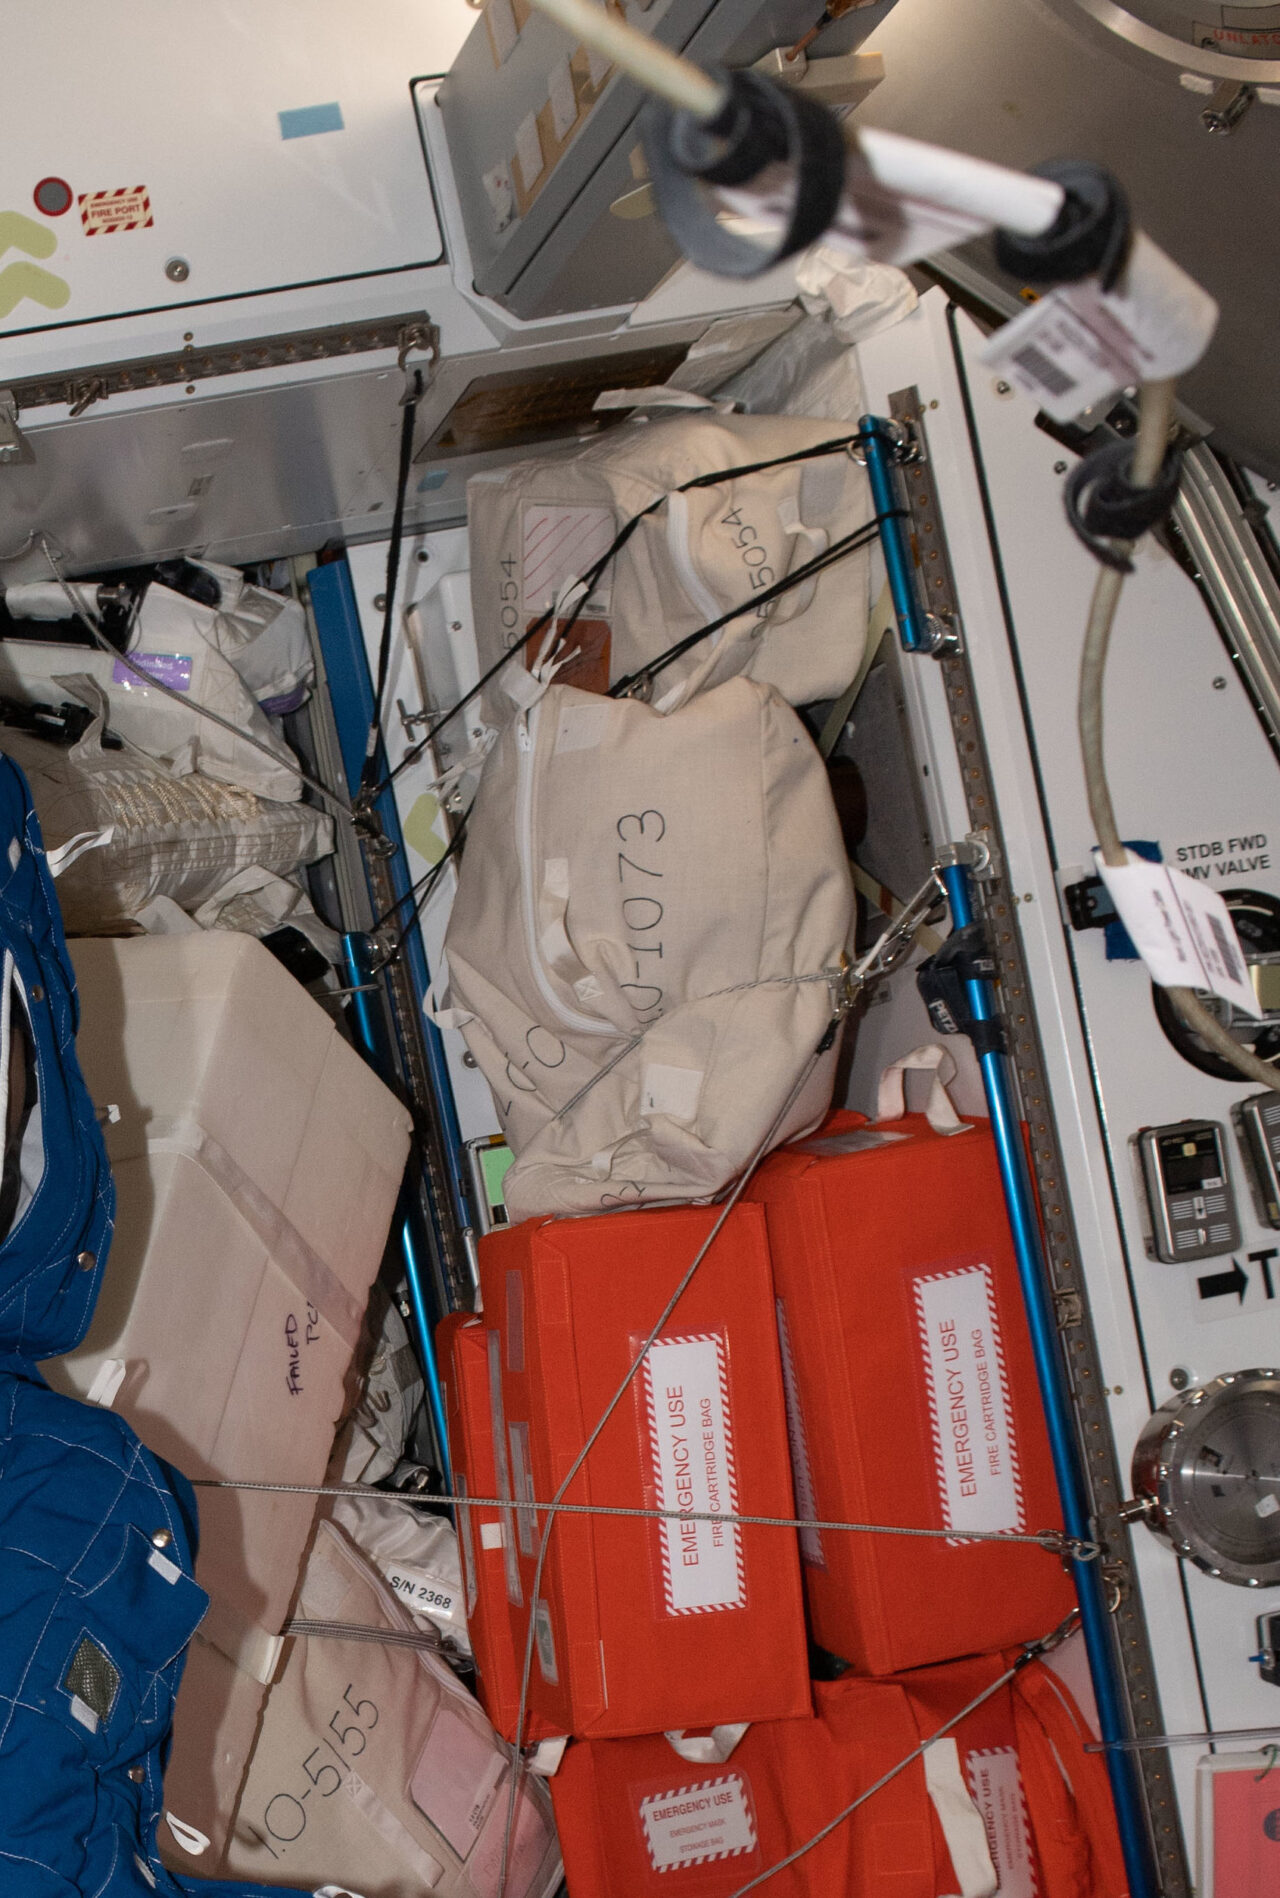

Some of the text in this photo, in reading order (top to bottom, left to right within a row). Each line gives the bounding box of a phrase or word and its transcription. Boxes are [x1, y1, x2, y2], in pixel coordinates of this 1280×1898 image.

[91, 207, 113, 219] FIRE
[115, 203, 141, 215] PORT
[1176, 833, 1268, 862] STDB FWD
[1219, 854, 1272, 877] VALVE
[281, 1312, 306, 1397] FAILED
[698, 1397, 714, 1440] BAG
[938, 1319, 977, 1498] EMERGENCY USE
[970, 1328, 1002, 1477] FIRE CARTRIDGE BAG
[666, 1385, 699, 1567] EMERGENCY USE
[702, 1442, 723, 1516] CARTRIDGE
[391, 1576, 452, 1609] S/N 2368
[981, 1768, 991, 1795] USE
[652, 1791, 734, 1822] EMERGENCY USE
[669, 1821, 707, 1838] EMERGENCY
